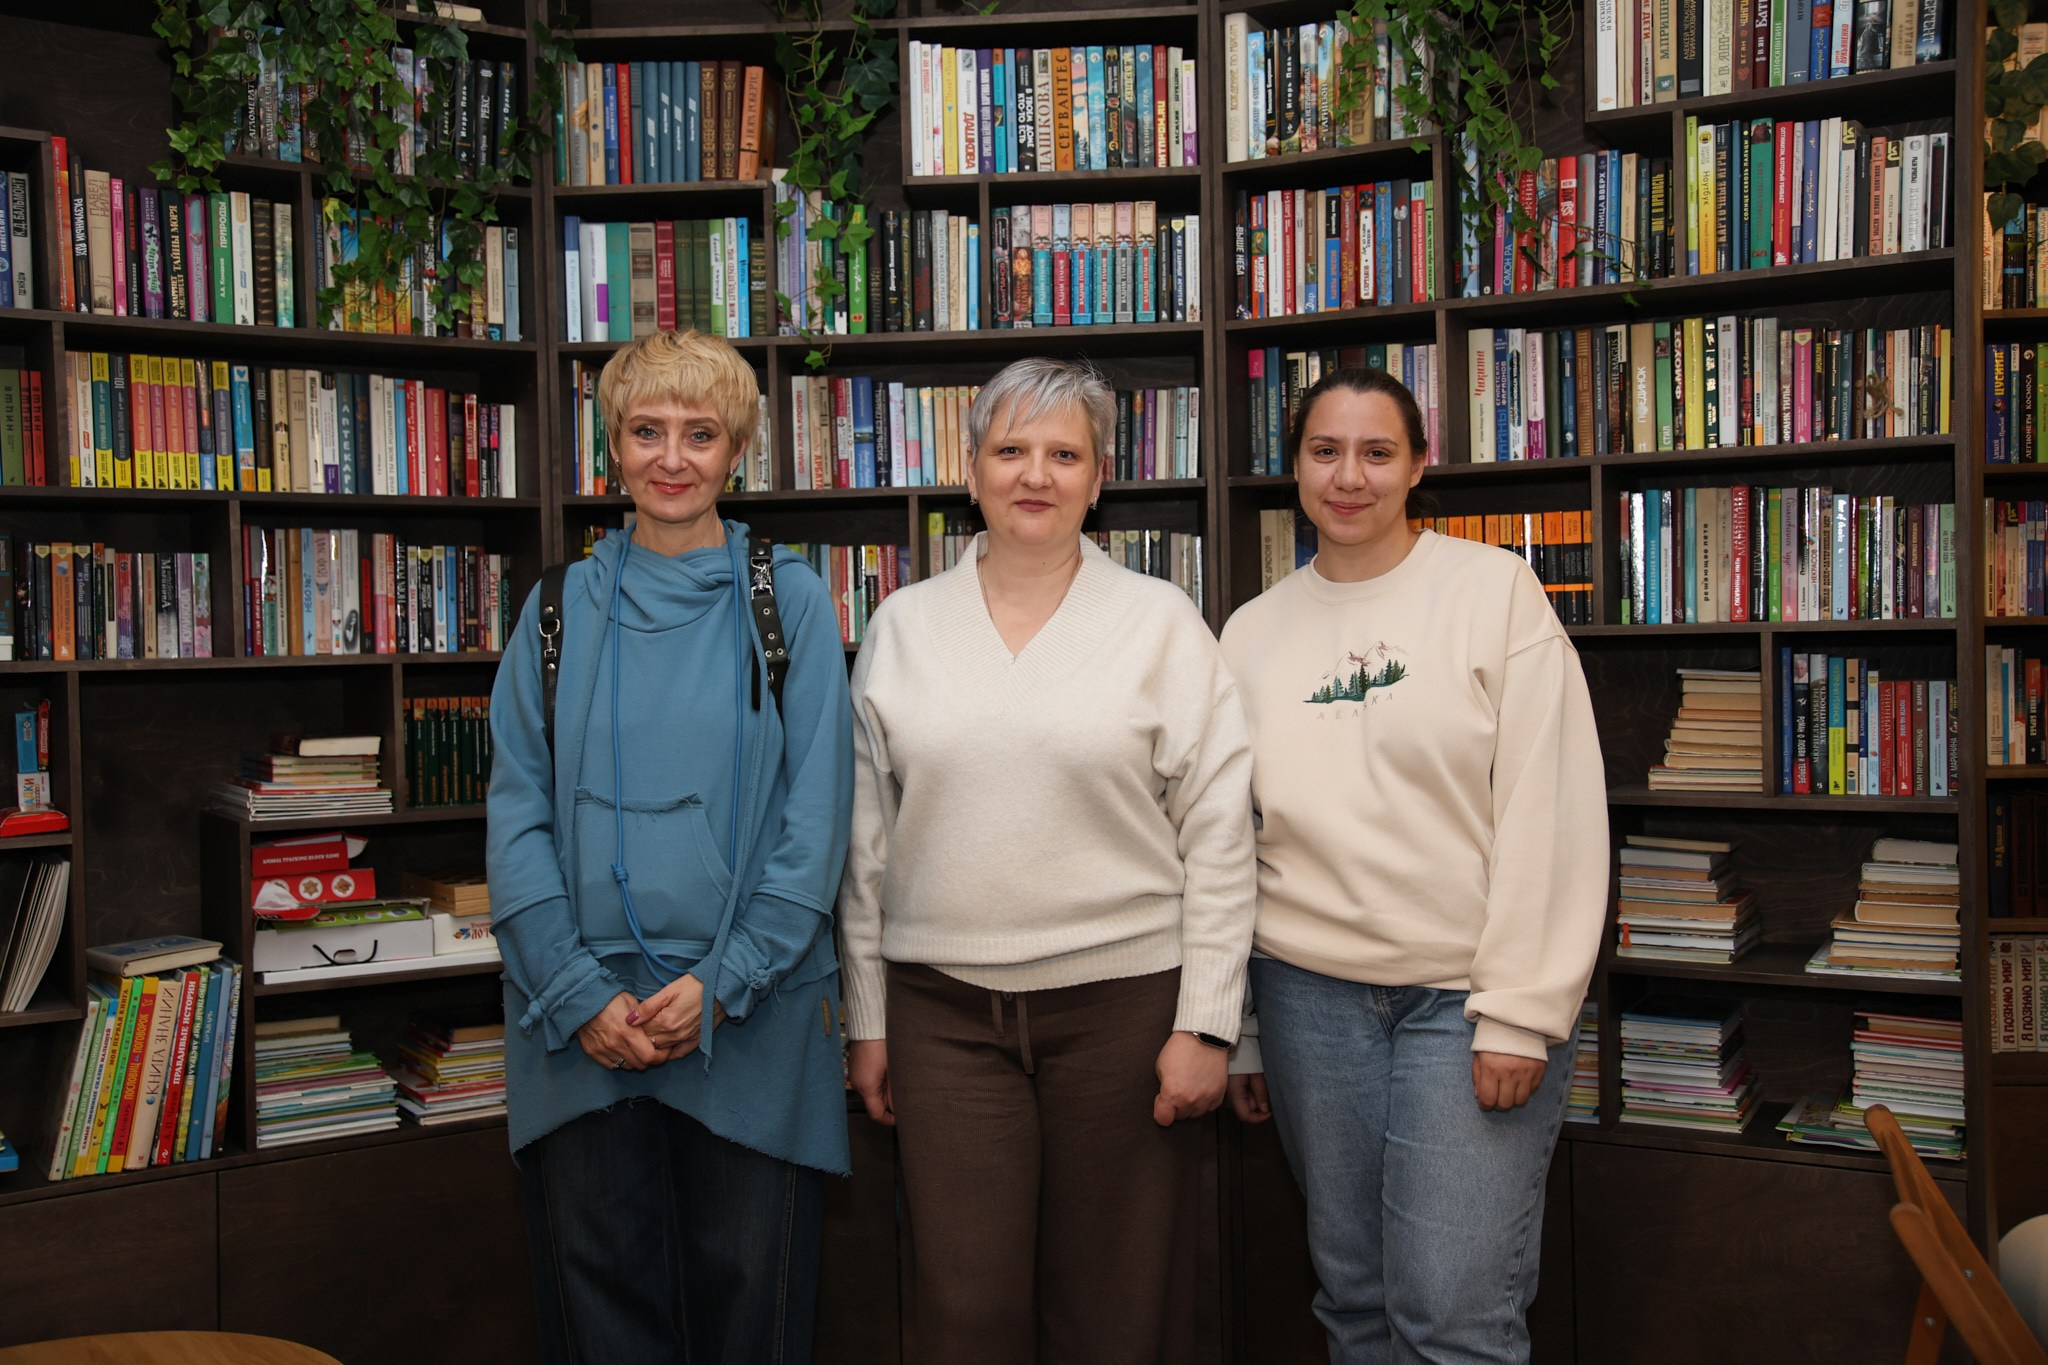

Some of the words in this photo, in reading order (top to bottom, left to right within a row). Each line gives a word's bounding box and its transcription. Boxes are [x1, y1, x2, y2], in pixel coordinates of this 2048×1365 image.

[1840, 24, 1849, 64] ЛУКЬЯНЕНКО
[247, 83, 256, 139] АГЛОМЕРАТ
[481, 95, 490, 119] РЕКС
[1025, 95, 1033, 122] ТВОЕМ
[1056, 54, 1069, 149] СЕРВАНТЕС
[964, 113, 975, 169] ДАШКОВА
[1018, 125, 1026, 143] ЕСТЬ
[1035, 81, 1051, 170] ДАШКОВА
[1717, 150, 1727, 179] ИГРЫ
[12, 178, 25, 220] БАЛЬМОНТ
[90, 179, 99, 216] ПАВЕЛ
[1652, 173, 1665, 206] ПРОПАСТЬ
[1702, 170, 1710, 206] Ноутбук
[73, 198, 86, 242] РАЗУМНЫЙ
[169, 205, 179, 236] МОРЯ
[218, 201, 228, 248] ПРИРОДЫ
[1651, 217, 1664, 232] ШАГ
[1717, 180, 1727, 242] КАРТОЧНЫЕ
[1236, 226, 1244, 252] ВЫШЕ
[1505, 244, 1513, 256] РА
[171, 239, 181, 272] ТАЙНЫ
[937, 229, 946, 283] ВОЗРОЖДЕНИЯ
[1236, 254, 1245, 276] НЕБА
[1504, 258, 1512, 285] ОМОН
[999, 263, 1007, 290] ПАНОВ
[938, 286, 946, 314] ПОЭТЫ
[1305, 292, 1315, 311] Дар
[1474, 350, 1486, 396] Чикита
[1674, 328, 1682, 400] Ф.МОУЭТ
[1815, 343, 1823, 373] АНОМАЛИЯ
[114, 377, 124, 389] 101
[1292, 366, 1300, 396] MAGUS
[1782, 383, 1790, 411] ТИЛЬЕ
[4, 385, 13, 431] НИЦШЕ
[33, 386, 41, 431] НИЦШЕ
[1268, 386, 1277, 432] РЕБЕНОК
[1497, 410, 1508, 460] ТАЙНЫ
[1662, 426, 1670, 445] СТИЛ
[1782, 413, 1791, 441] ФРАНК
[388, 463, 394, 473] ТЫ
[814, 455, 823, 489] АРБАТА
[1738, 489, 1746, 556] МАРИНИНА
[399, 584, 407, 604] НОРА
[181, 588, 191, 643] КУЛИКОВА
[1812, 688, 1820, 725] БАРБЕРИ
[1882, 688, 1891, 741] МАРИНИНА
[2029, 689, 2038, 713] ВЕЛИКАЯ
[1916, 728, 1924, 748] НОЧЬЮ
[2030, 715, 2038, 736] БОРЬБА
[1812, 726, 1820, 763] МЮРИЕЛЬ
[1950, 737, 1958, 769] МАРИНИНА
[1916, 749, 1924, 774] ПРИХОДИТ
[1951, 770, 1958, 778] А.
[1916, 775, 1924, 791] ПАЛАЧ
[2002, 959, 2012, 983] МИР
[2022, 958, 2031, 981] МИР
[119, 989, 129, 1016] КНИГА
[196, 981, 207, 1022] ЖИВОТНЫЙ
[233, 973, 242, 1016] ЖИВОТНЫЙ
[2003, 987, 2014, 1032] ПОЗНАЮ
[2022, 985, 2033, 1030] ПОЗНАЮ
[112, 1017, 124, 1050] ПЕРВАЯ
[173, 1030, 191, 1085] ПРАВДИВЫЕ
[184, 980, 197, 1028] ИСТОРИИ
[230, 1017, 238, 1037] МИР
[2003, 1035, 2015, 1043] Я
[2022, 1033, 2033, 1041] Я
[109, 1051, 117, 1065] МОЯ
[124, 1062, 140, 1100] ПОСЛОВИЦ
[133, 1014, 148, 1053] ПОГОВОРОК
[146, 1048, 166, 1096] КНИГА
[82, 1126, 91, 1150] САМЫЕ
[87, 1089, 96, 1125] ЛЮБИМЫЕ
